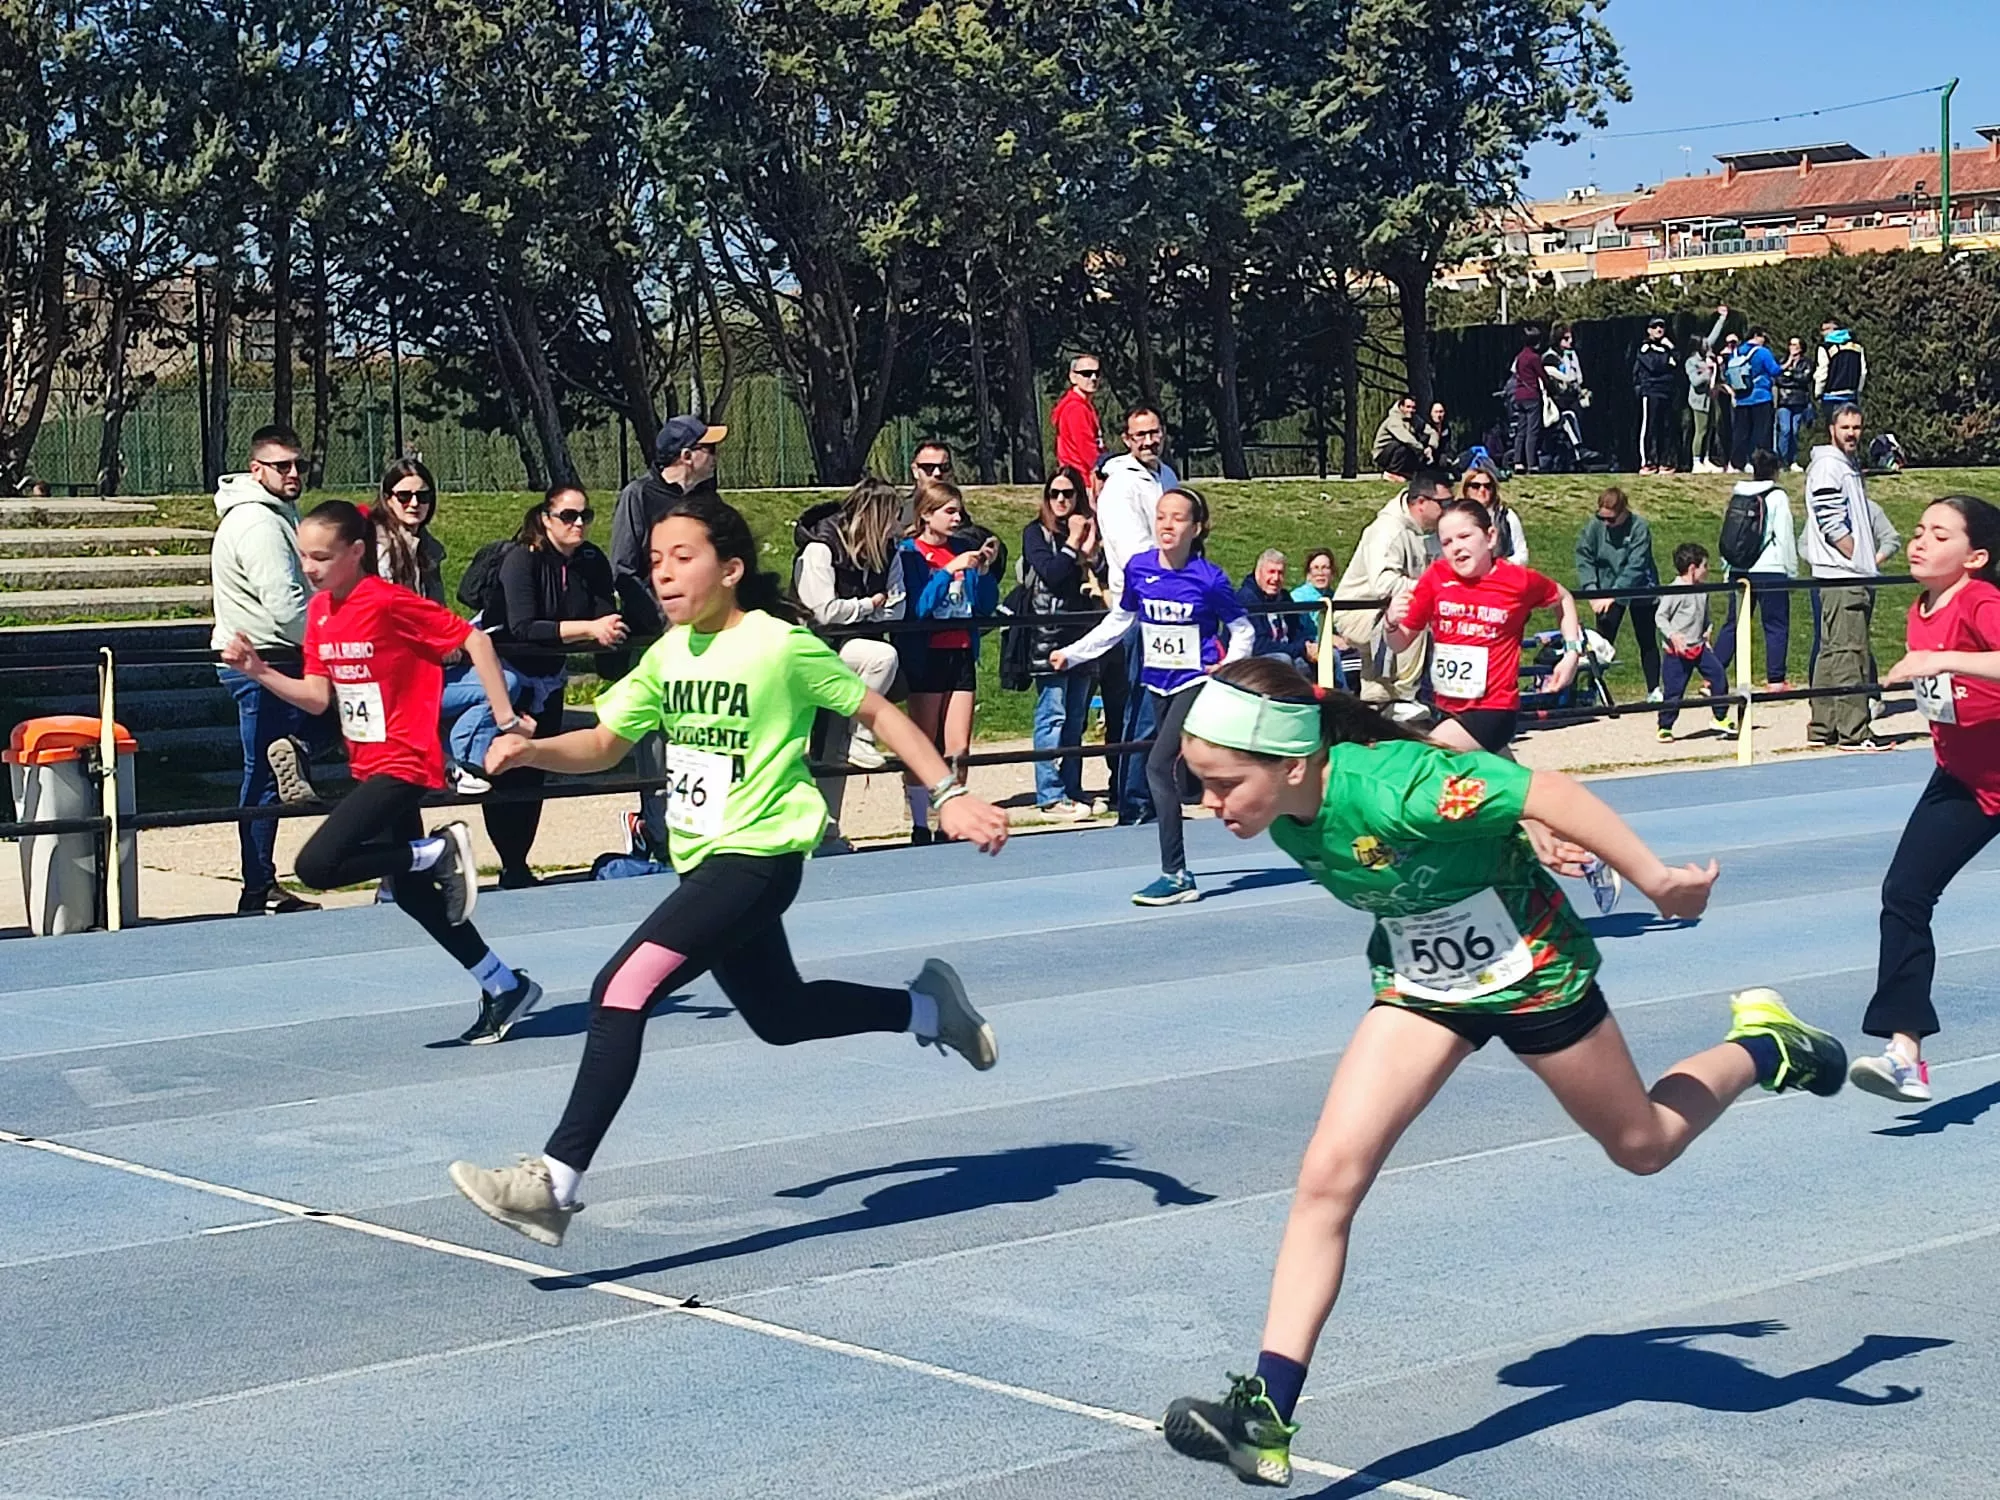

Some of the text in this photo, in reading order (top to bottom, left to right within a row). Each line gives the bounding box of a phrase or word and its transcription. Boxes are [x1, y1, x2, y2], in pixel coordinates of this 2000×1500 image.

[1152, 636, 1185, 655] 461
[1436, 658, 1473, 680] 592
[662, 680, 750, 718] AMYPA
[1410, 925, 1495, 975] 506
